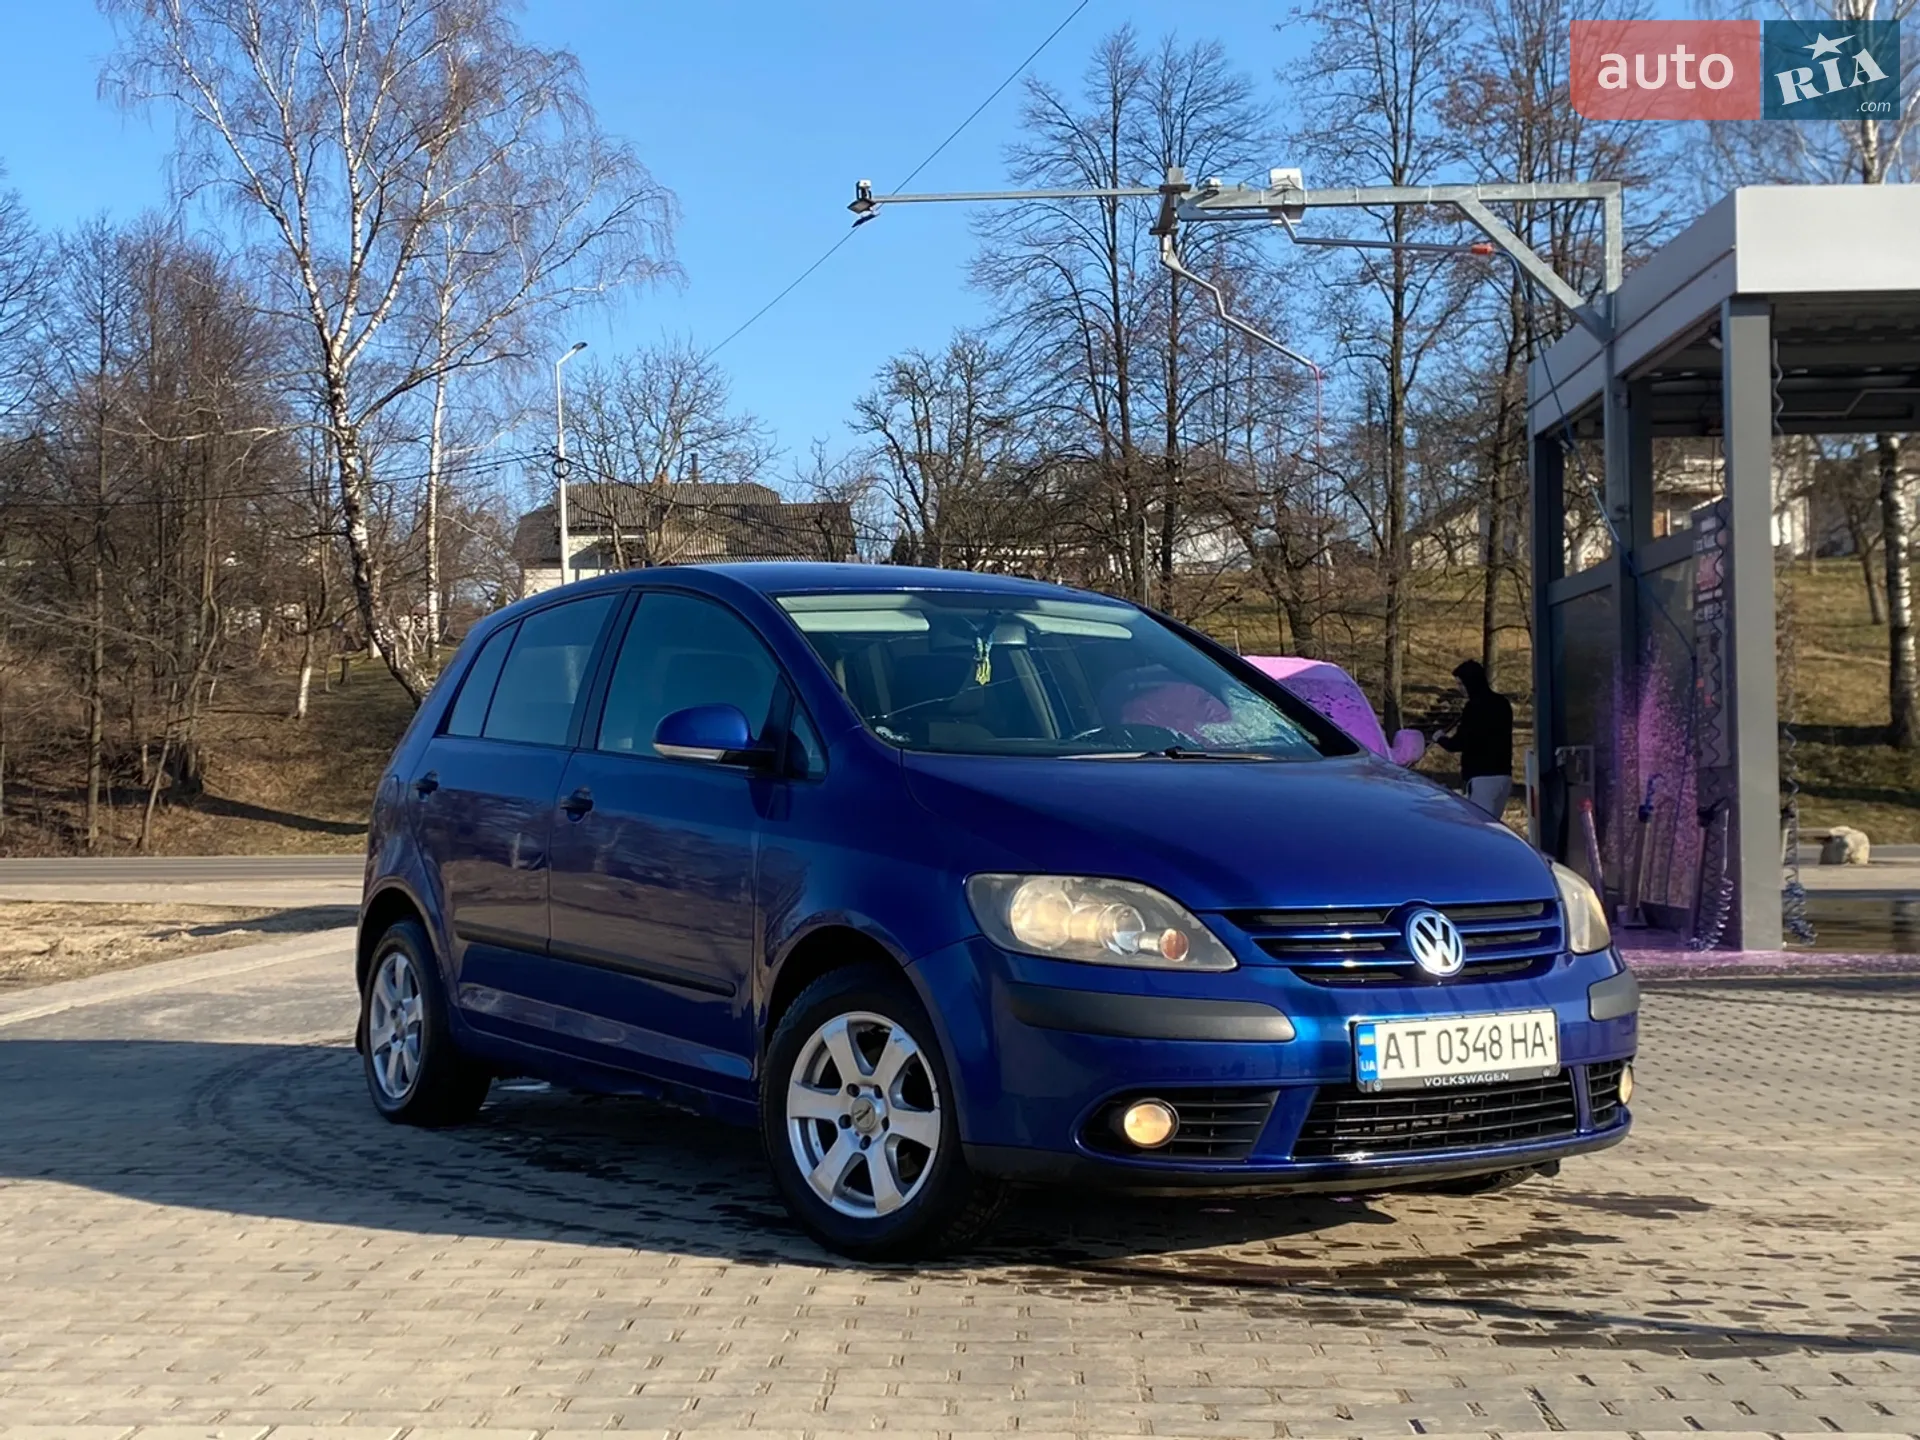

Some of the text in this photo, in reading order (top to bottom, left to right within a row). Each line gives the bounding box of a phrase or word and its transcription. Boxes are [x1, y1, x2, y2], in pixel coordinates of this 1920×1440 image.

[1383, 1021, 1548, 1070] AT 0348 HA
[1360, 1061, 1376, 1072] UA
[1424, 1072, 1510, 1087] VOLKSWAGEN
